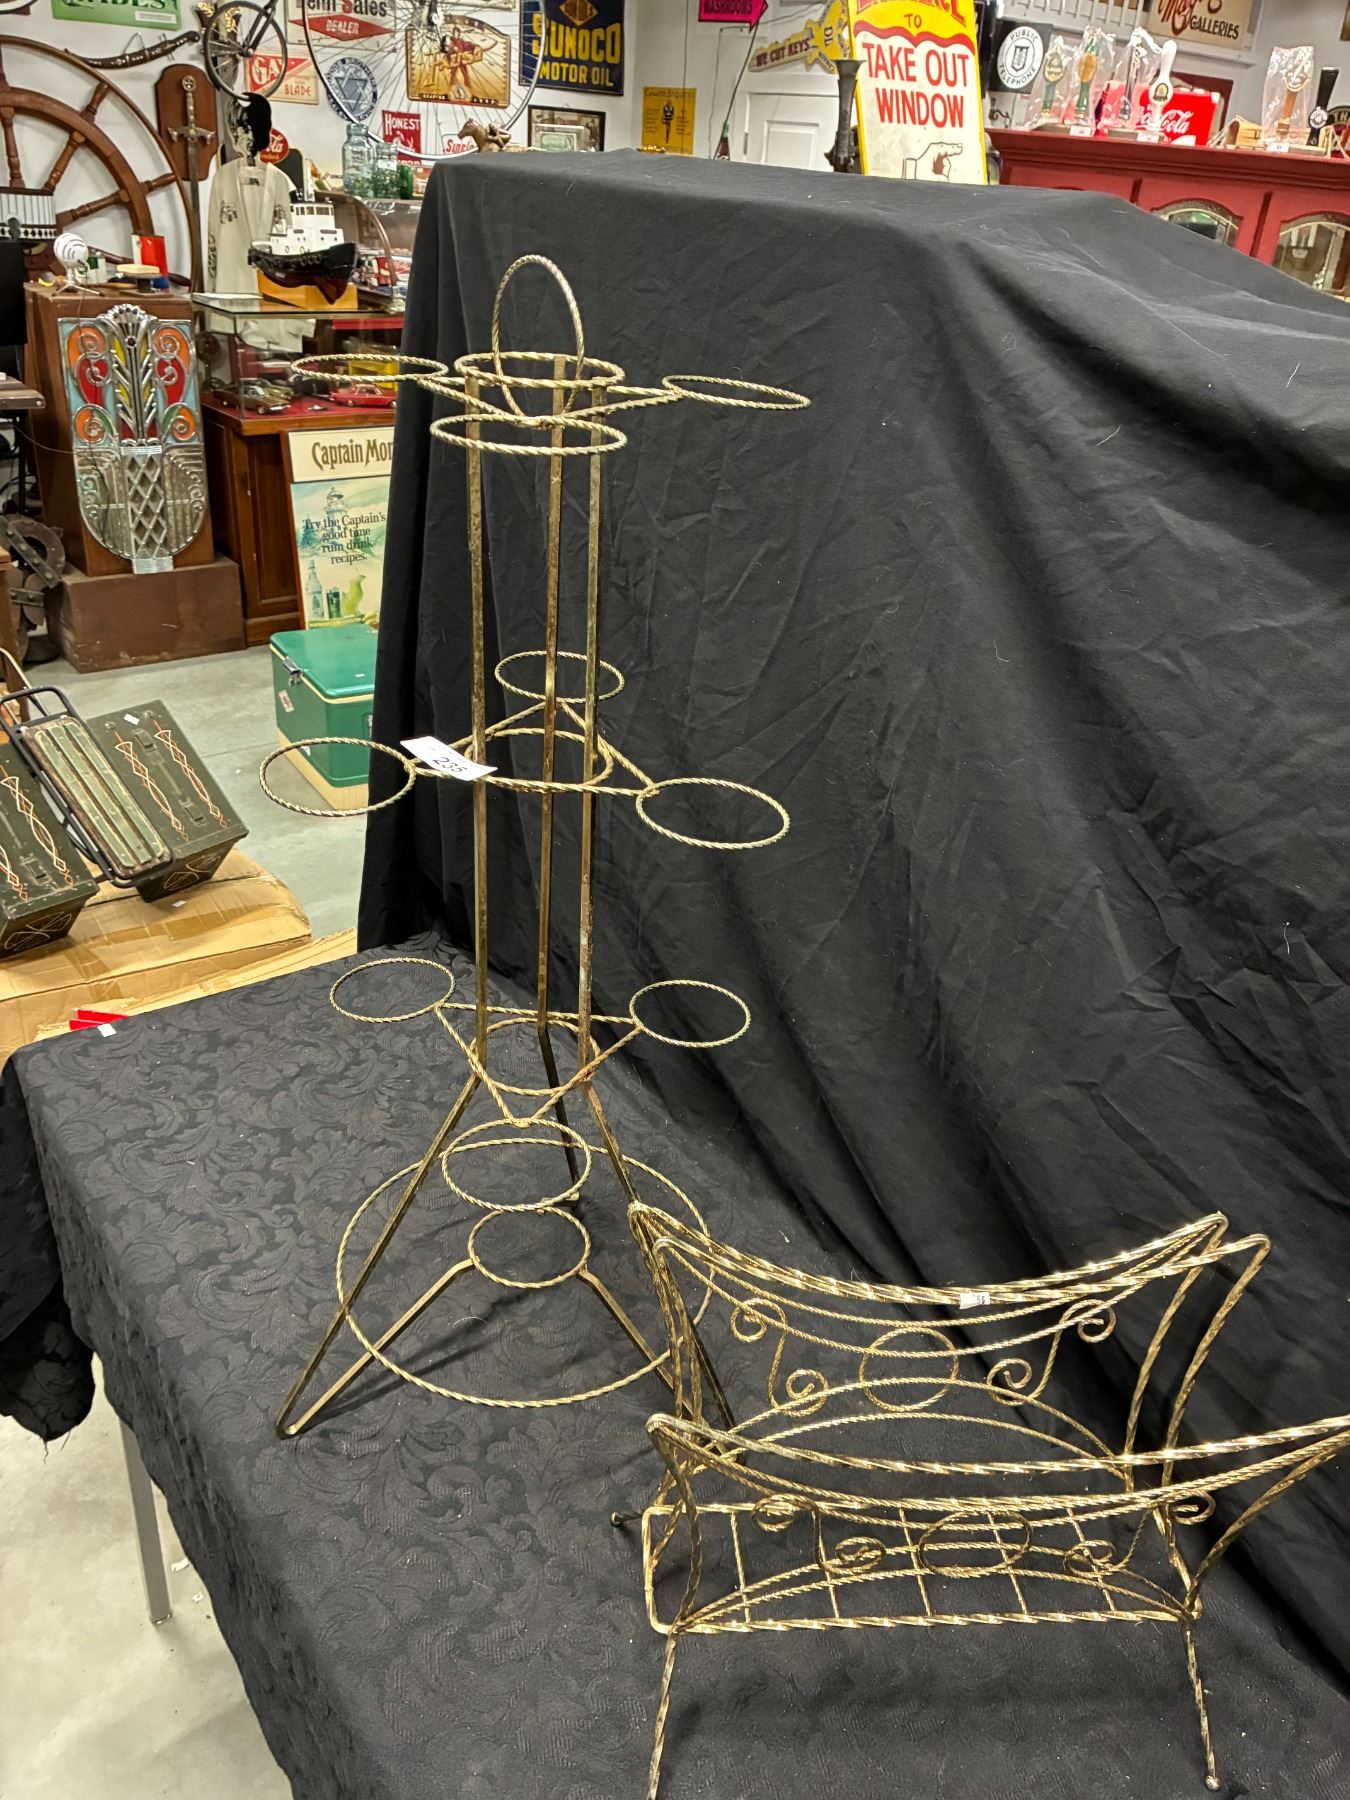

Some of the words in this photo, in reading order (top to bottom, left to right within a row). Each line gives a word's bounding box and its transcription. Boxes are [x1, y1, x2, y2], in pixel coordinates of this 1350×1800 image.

[326, 20, 359, 34] DEALER
[904, 13, 922, 29] TO
[1189, 15, 1239, 40] GALLERIES
[532, 13, 621, 64] SUNOCO
[1010, 29, 1038, 43] PUBLIC
[757, 53, 768, 67] WE
[770, 47, 786, 62] CUT
[788, 38, 810, 56] KEYS
[539, 61, 588, 84] MOTOR
[591, 66, 614, 87] OIL
[862, 42, 917, 82] TAKE
[925, 49, 969, 87] OUT
[1000, 62, 1036, 85] TELEPHONE
[284, 83, 312, 96] BLADE
[875, 87, 964, 128] WINDOW
[1335, 111, 1350, 122] TH
[385, 113, 421, 135] HONEST
[312, 439, 364, 471] Captain
[323, 516, 339, 530] the
[342, 512, 386, 528] Captain's
[322, 527, 347, 542] good
[349, 525, 371, 538] time
[322, 544, 344, 553] rum
[346, 539, 373, 551] drink
[331, 553, 368, 566] recipes.
